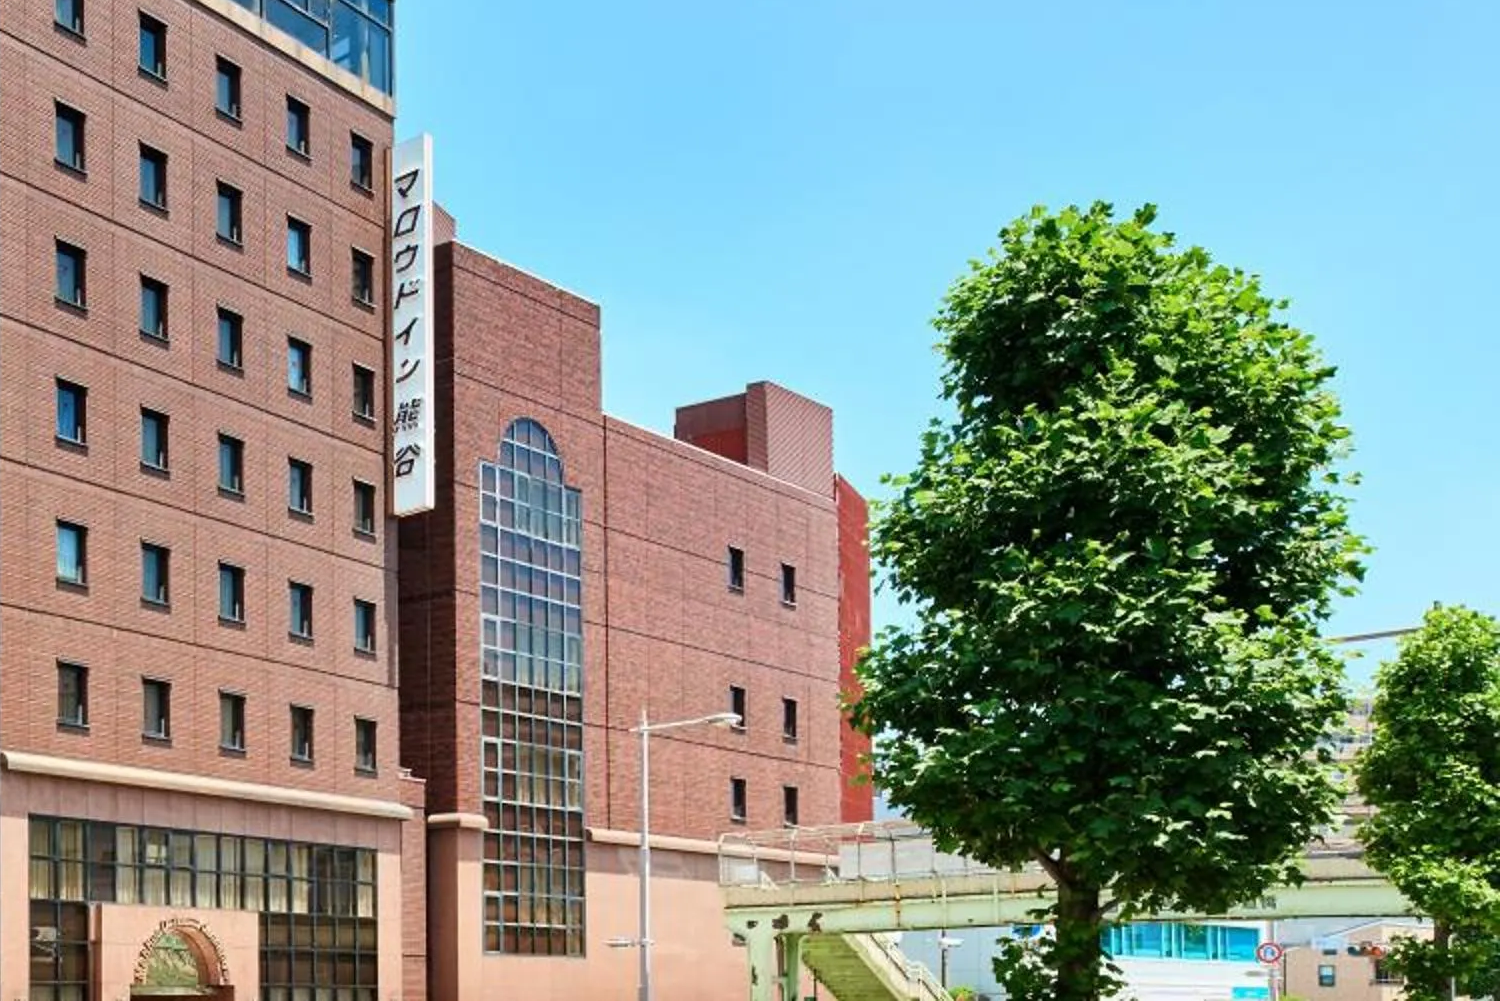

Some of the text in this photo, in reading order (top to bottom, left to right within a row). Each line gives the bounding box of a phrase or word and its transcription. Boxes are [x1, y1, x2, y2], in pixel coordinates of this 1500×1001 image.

[394, 169, 421, 478] マロウドイン熊谷
